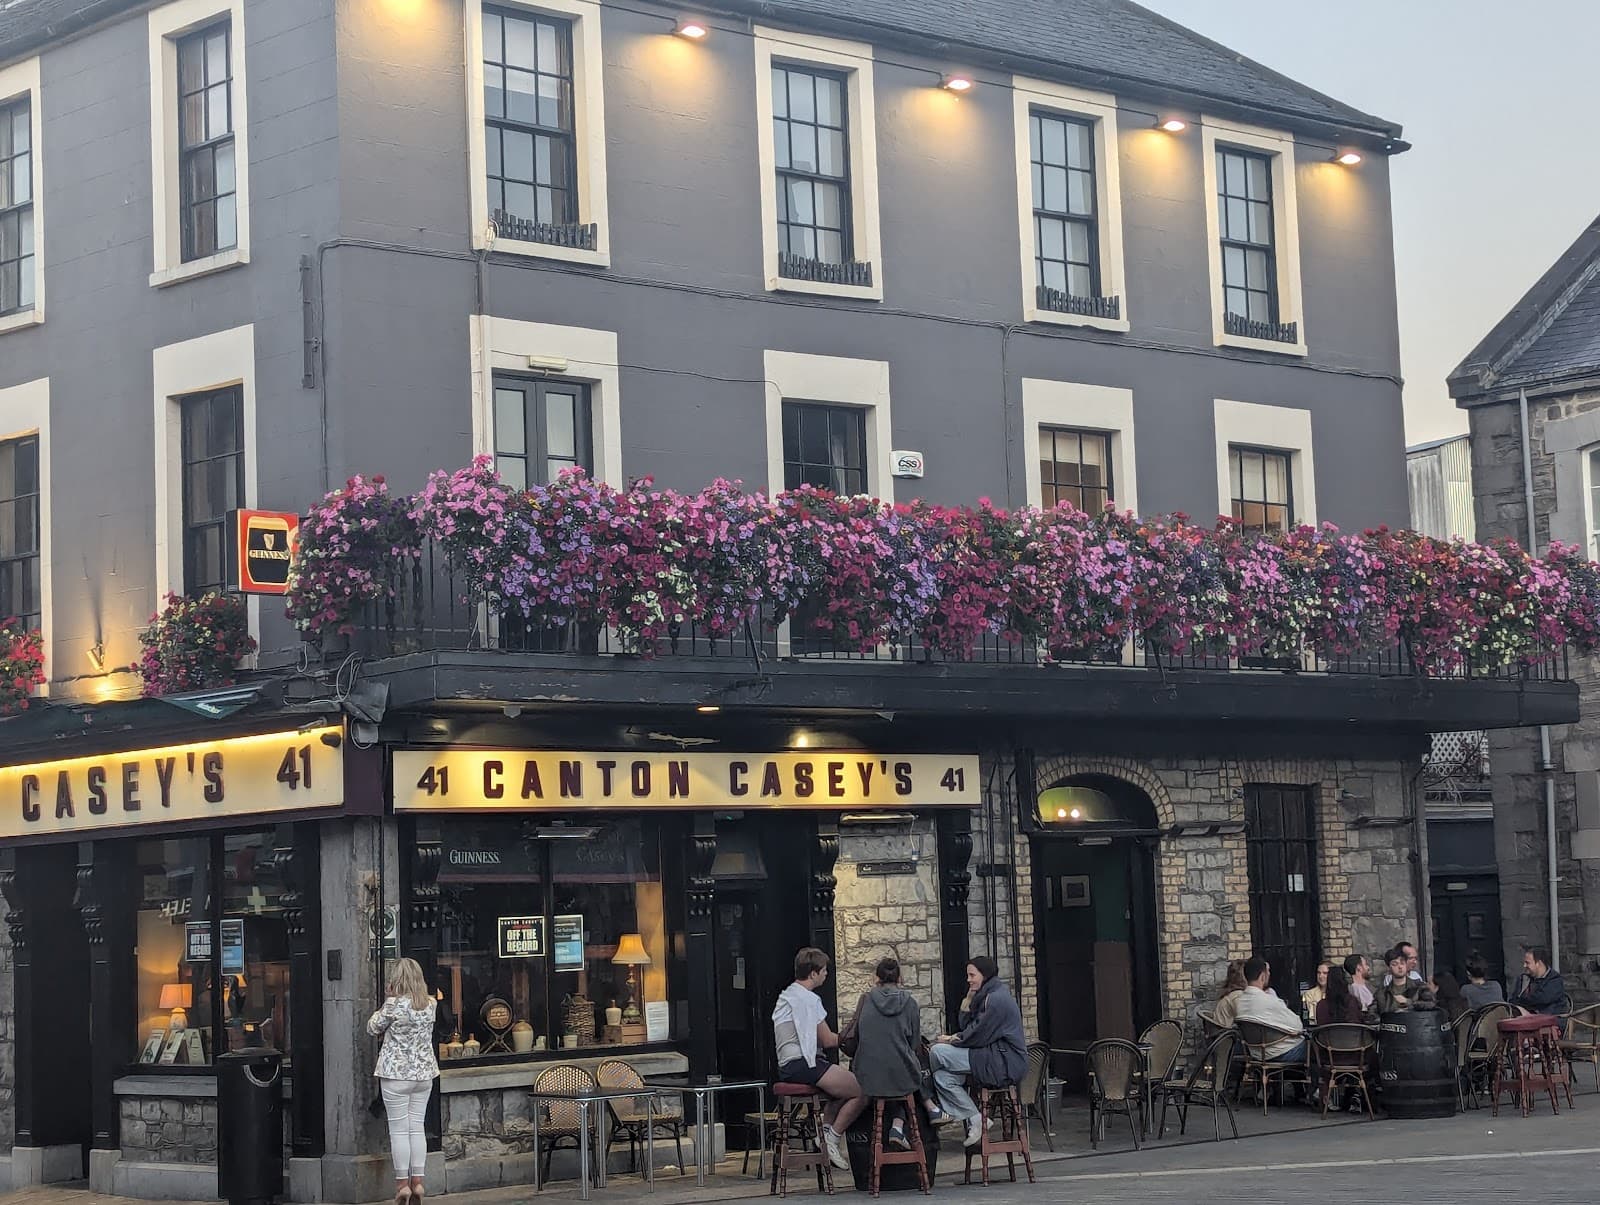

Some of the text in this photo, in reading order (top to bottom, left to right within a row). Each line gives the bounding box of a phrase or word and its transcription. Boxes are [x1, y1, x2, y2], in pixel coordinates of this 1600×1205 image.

[249, 549, 290, 560] GUINNESS
[21, 744, 312, 822] CASEY'S 41
[417, 760, 966, 800] 41 CANTON CASEY'S 41
[449, 849, 500, 864] GUINNESS
[506, 928, 537, 941] OFF THE
[506, 940, 538, 953] RECORD
